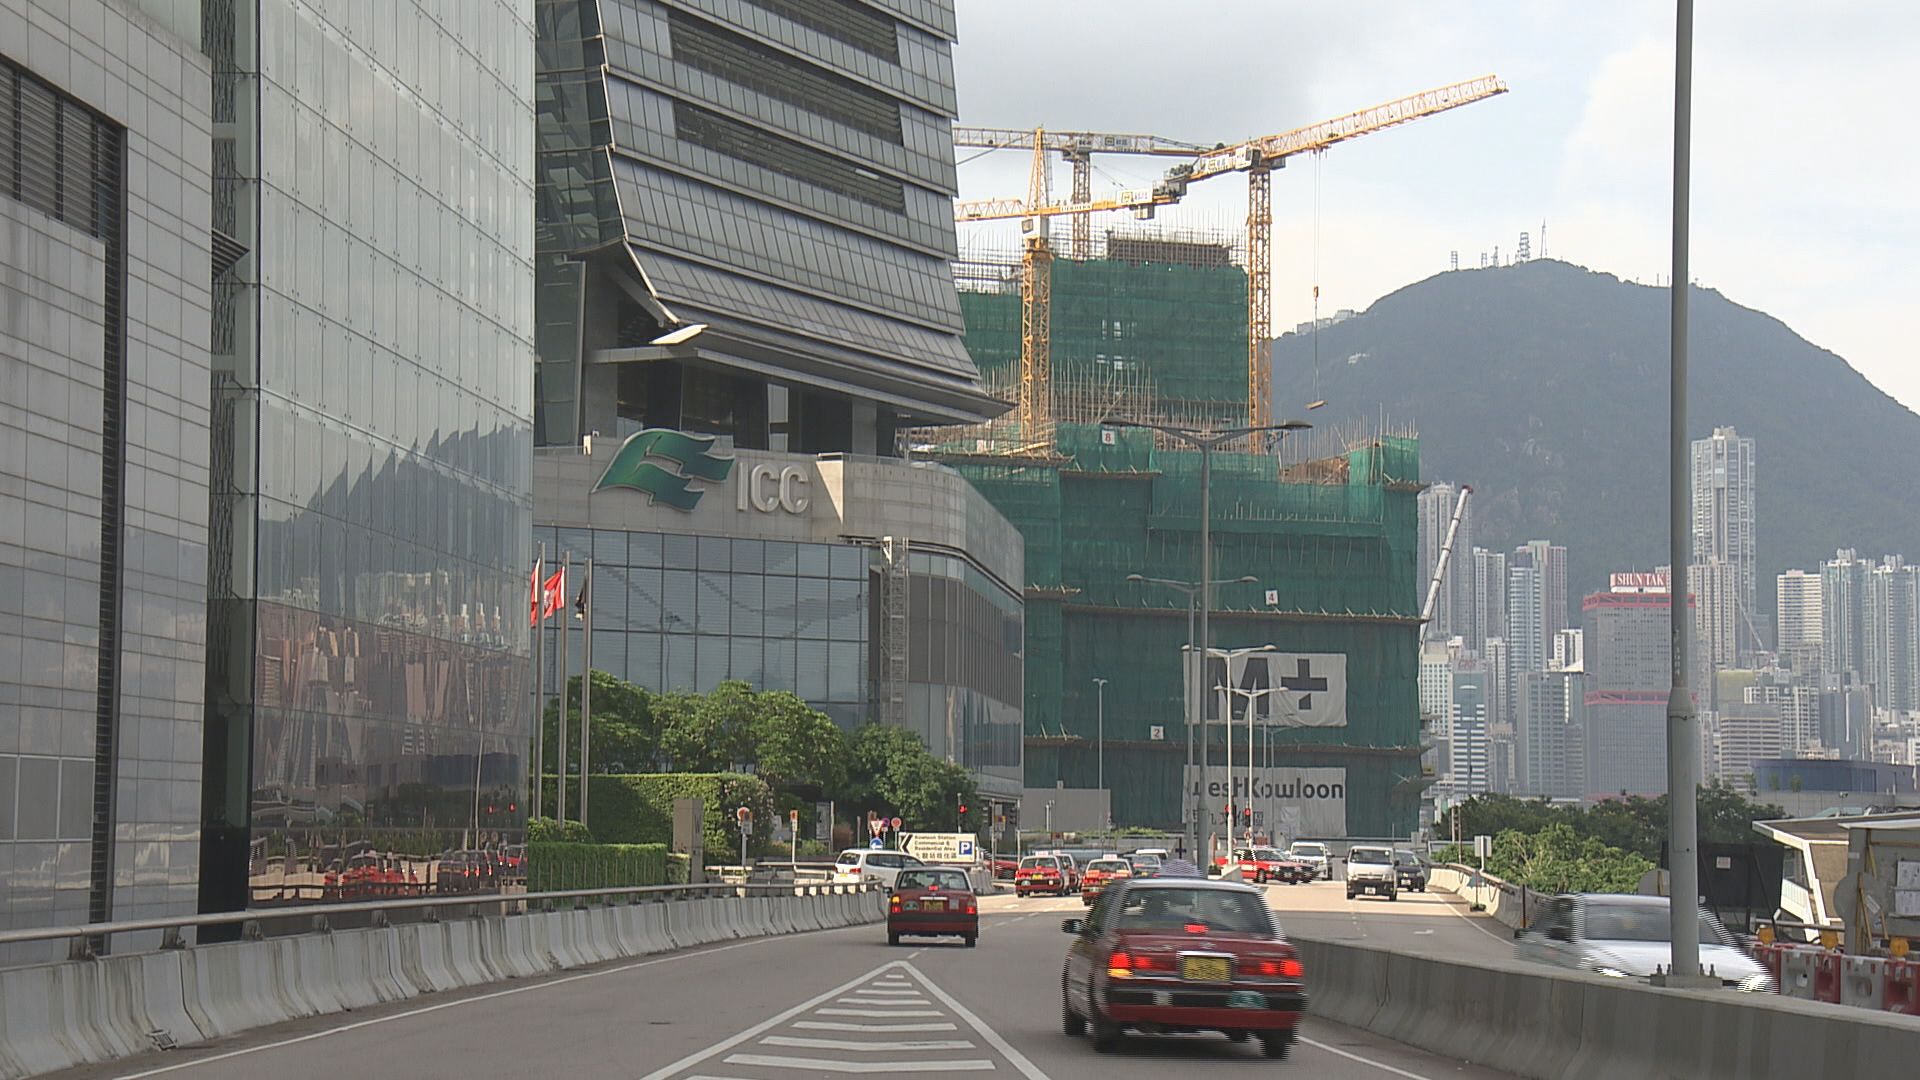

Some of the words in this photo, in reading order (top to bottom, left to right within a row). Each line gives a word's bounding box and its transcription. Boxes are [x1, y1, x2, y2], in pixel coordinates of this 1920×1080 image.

[736, 462, 809, 513] ICC
[1617, 573, 1642, 586] SHUN
[1645, 572, 1665, 586] TAK
[960, 842, 971, 854] P
